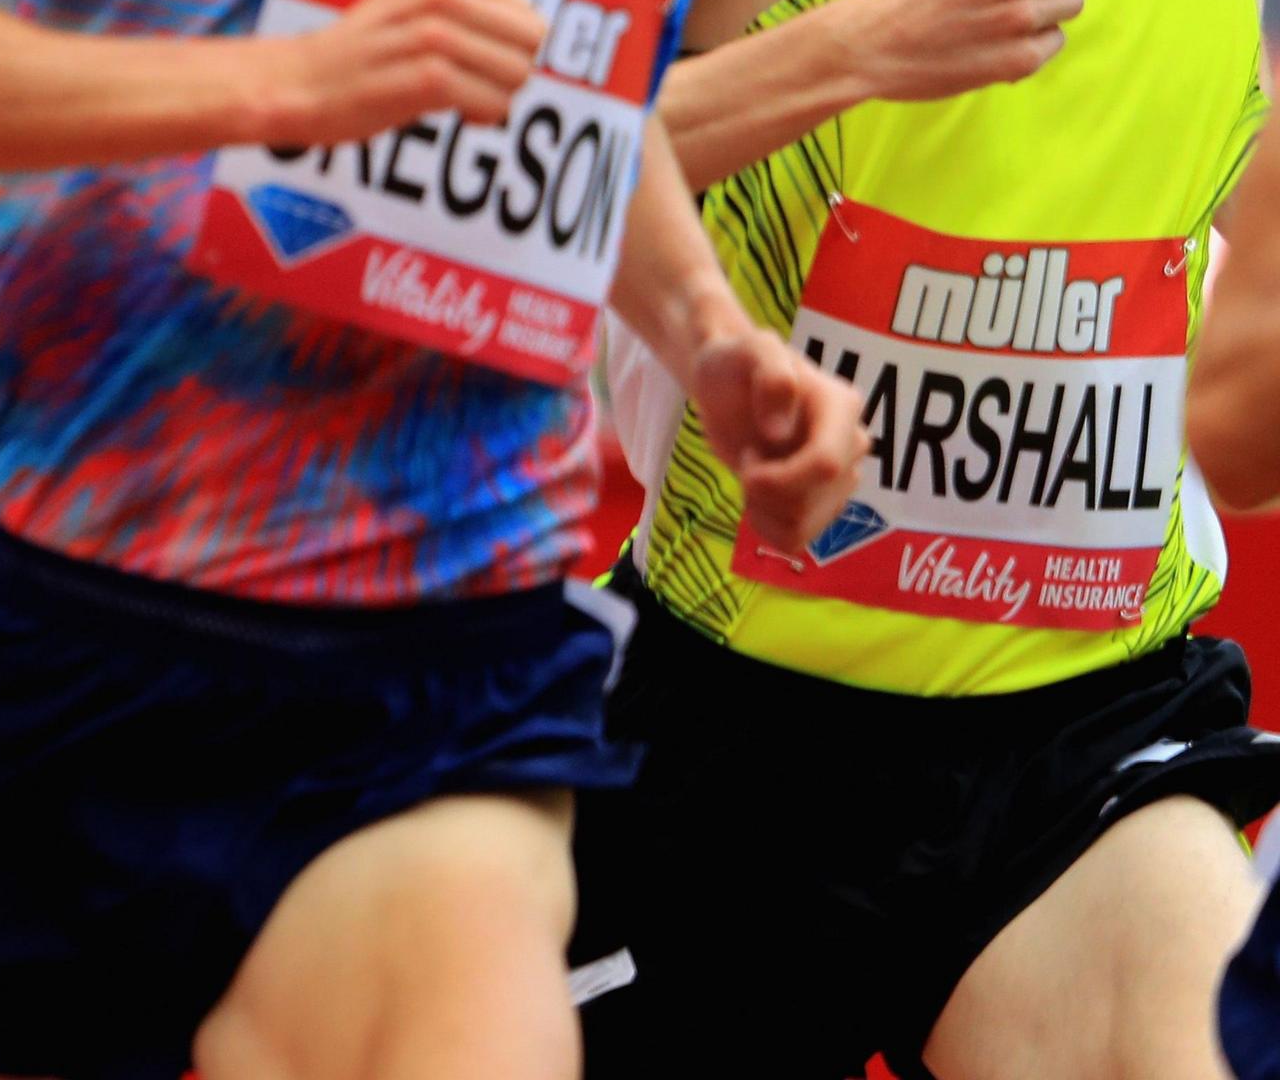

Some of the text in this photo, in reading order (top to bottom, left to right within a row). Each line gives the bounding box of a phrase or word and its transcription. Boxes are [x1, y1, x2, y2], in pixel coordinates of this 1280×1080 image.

[890, 248, 1126, 353] müller
[897, 536, 1031, 622] Vitality
[1044, 554, 1122, 582] HEALTH
